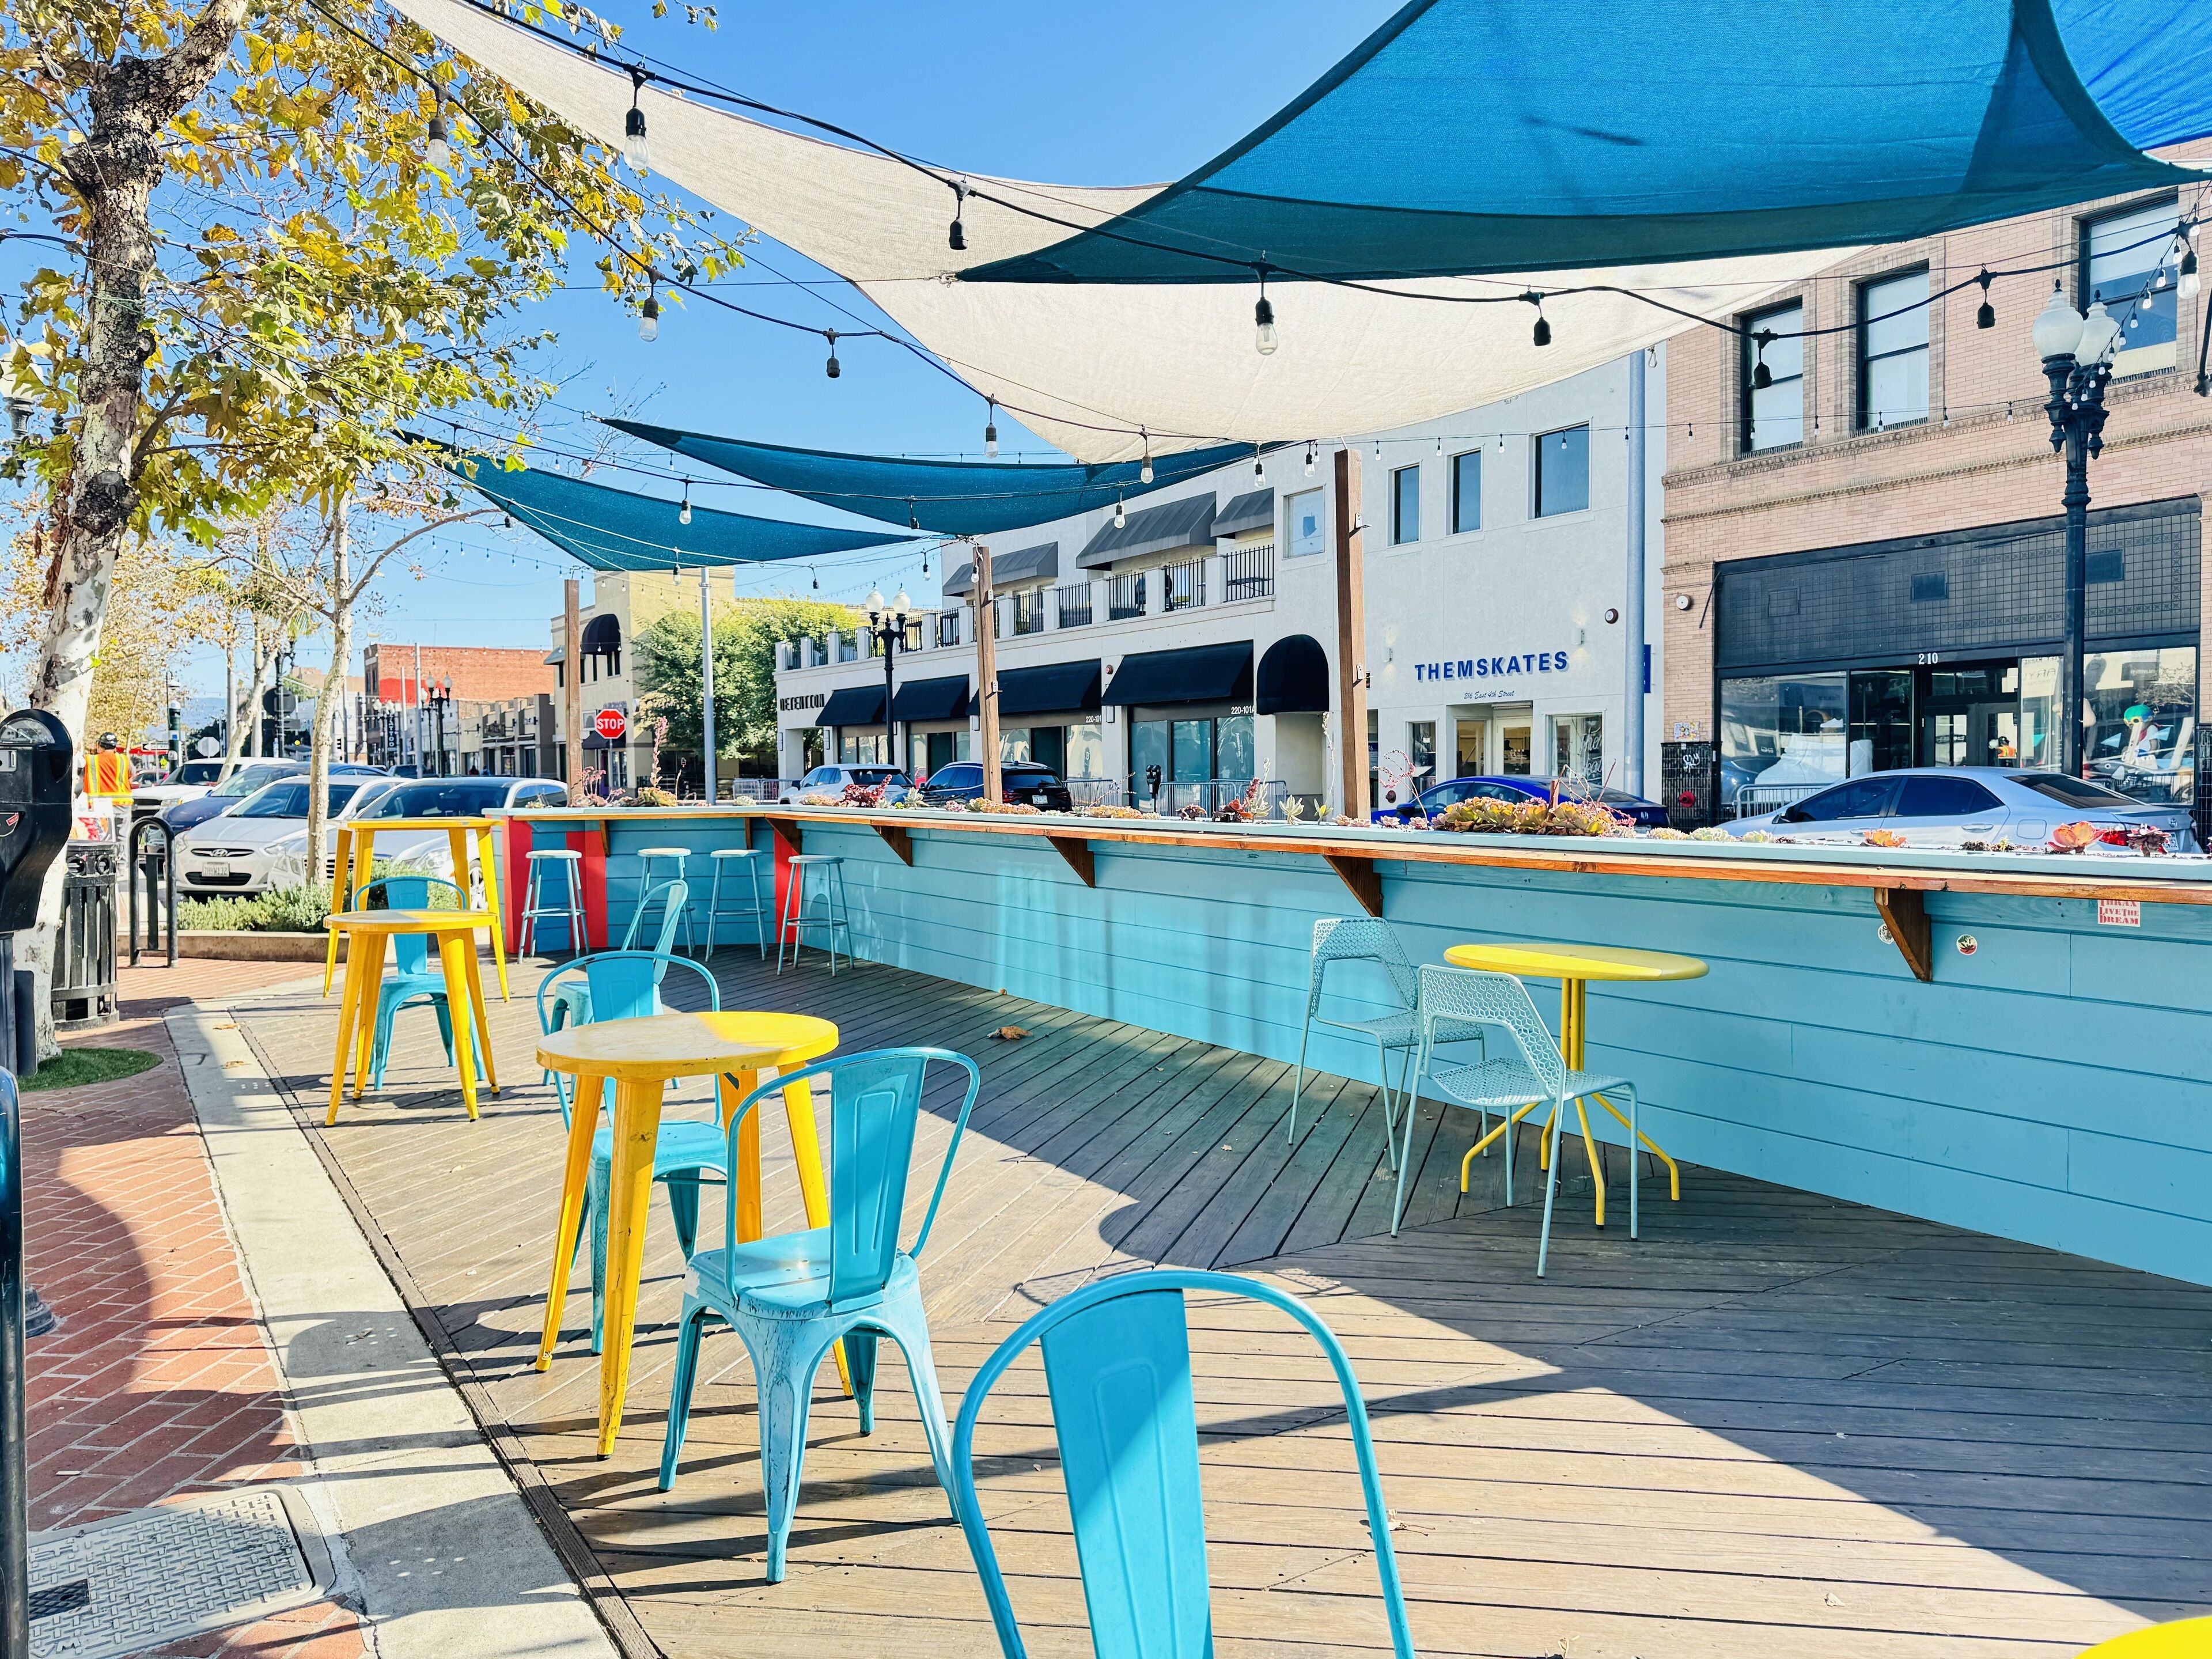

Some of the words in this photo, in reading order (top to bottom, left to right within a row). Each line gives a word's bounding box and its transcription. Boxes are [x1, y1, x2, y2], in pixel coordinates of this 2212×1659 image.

[1918, 653, 1938, 665] 210
[1415, 651, 1567, 681] THEMSKATES
[597, 718, 624, 730] STOP
[2100, 915, 2139, 925] DREAM
